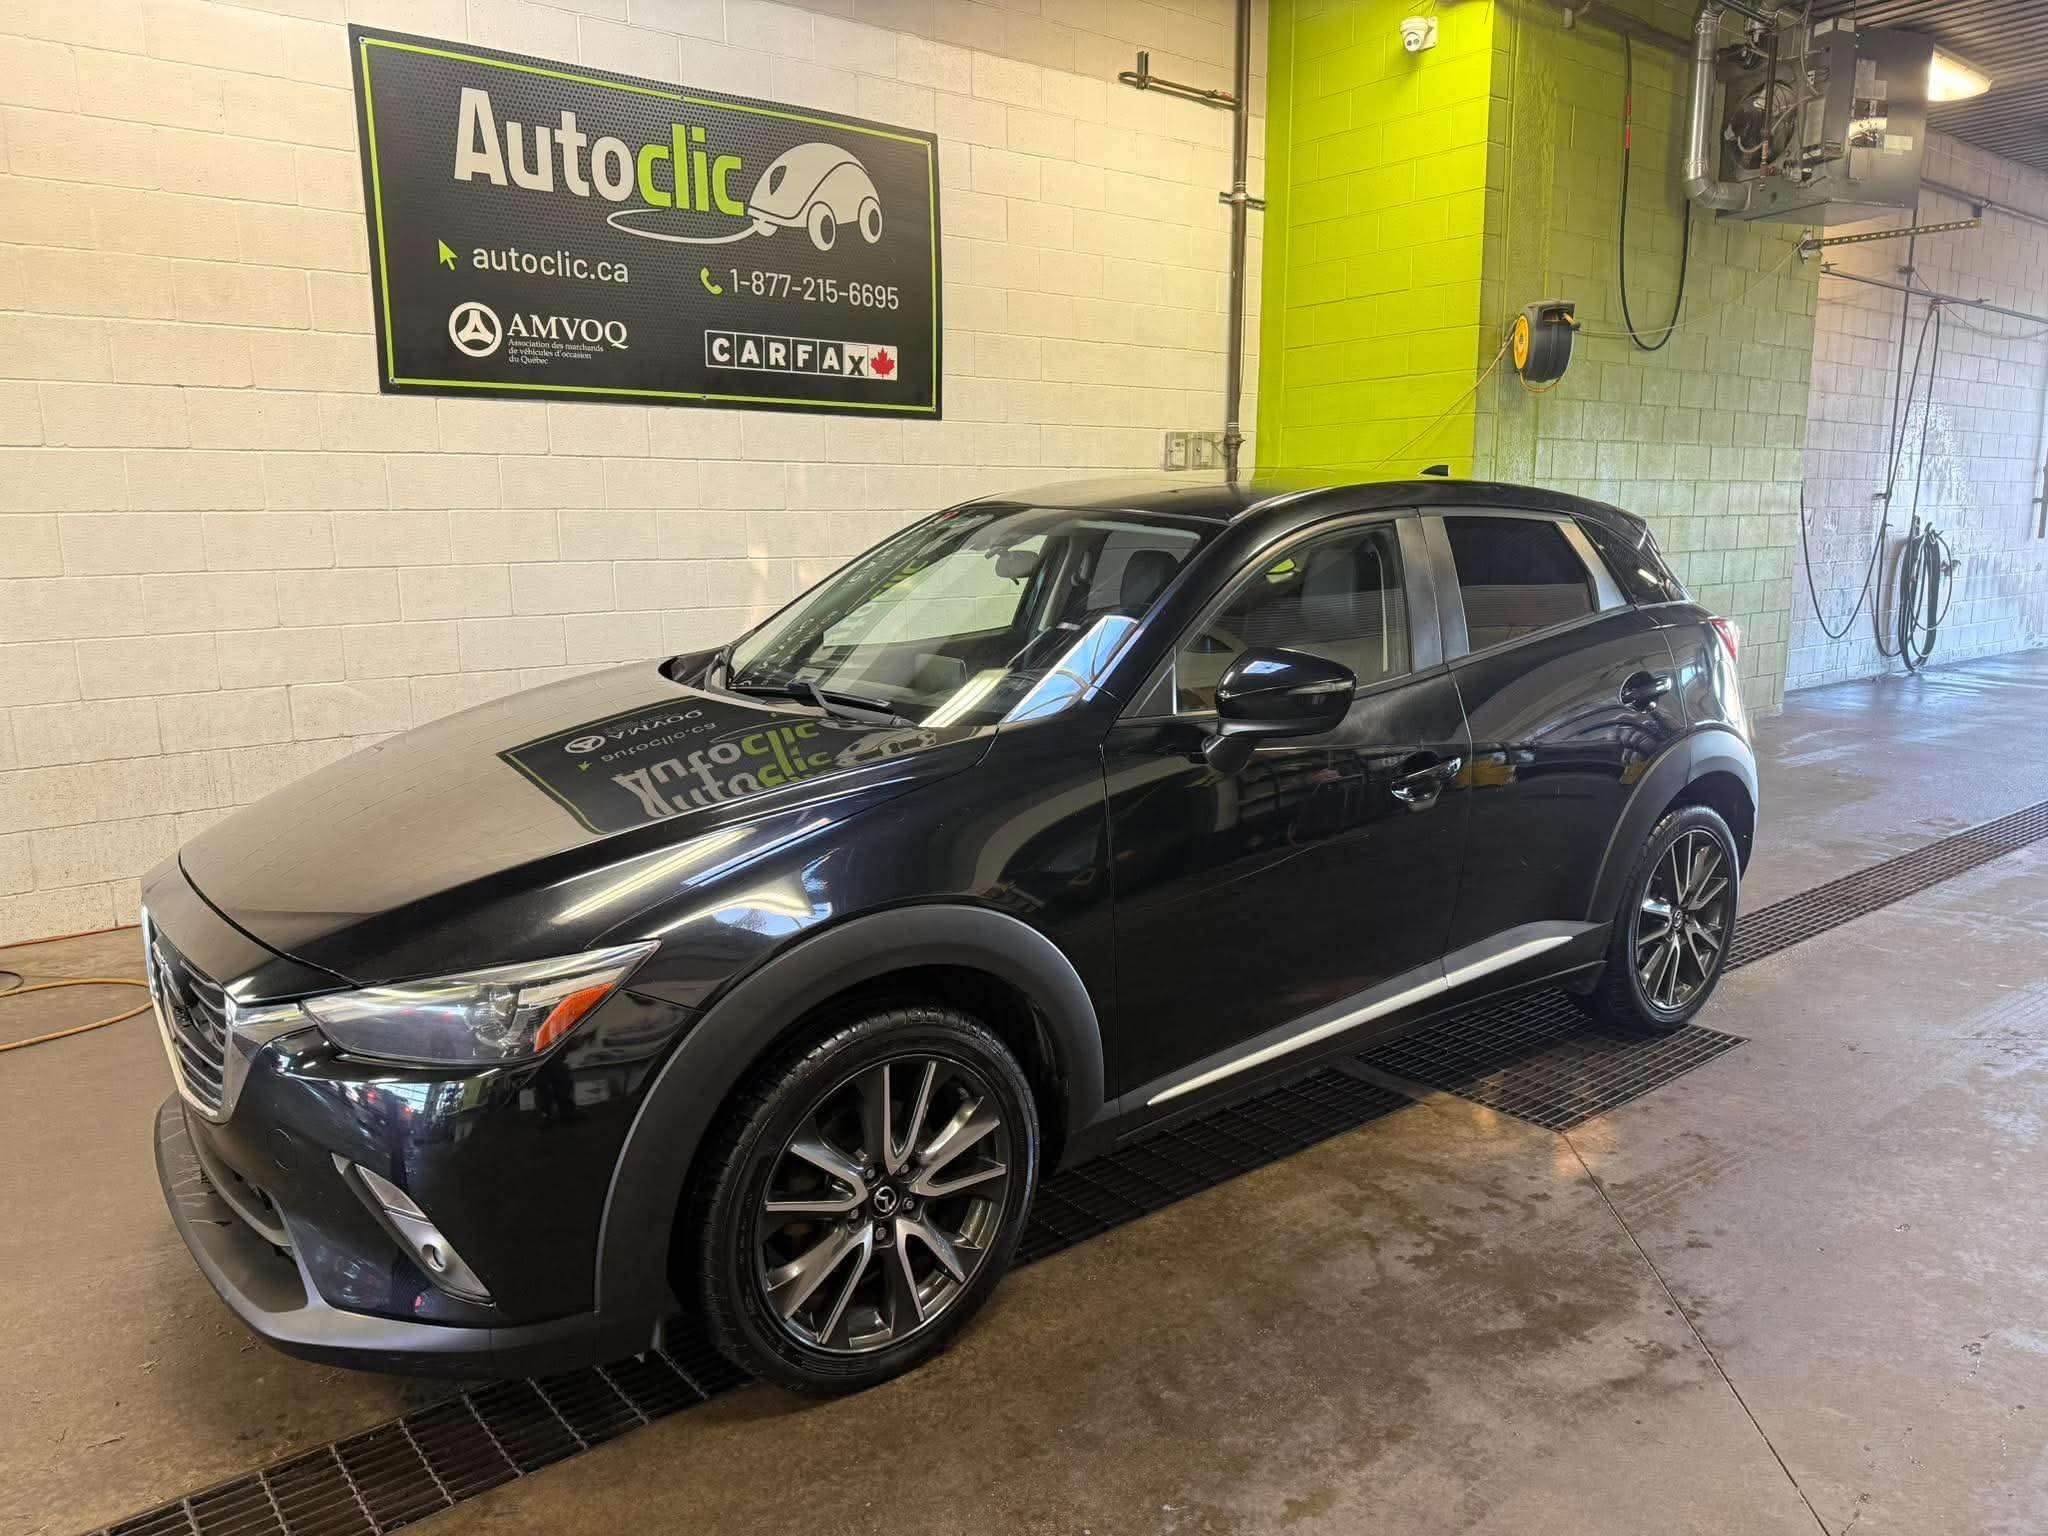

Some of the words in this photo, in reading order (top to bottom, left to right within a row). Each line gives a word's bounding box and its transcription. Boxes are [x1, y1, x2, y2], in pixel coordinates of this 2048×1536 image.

[454, 87, 744, 217] Autoclic
[472, 247, 629, 283] autoclic.ca
[729, 268, 899, 310] 1-877-215-6695
[507, 313, 629, 349] AMVOQ
[508, 339, 550, 349] Association
[565, 343, 604, 352] marchands
[508, 355, 519, 363] du
[711, 337, 866, 377] CARFAX
